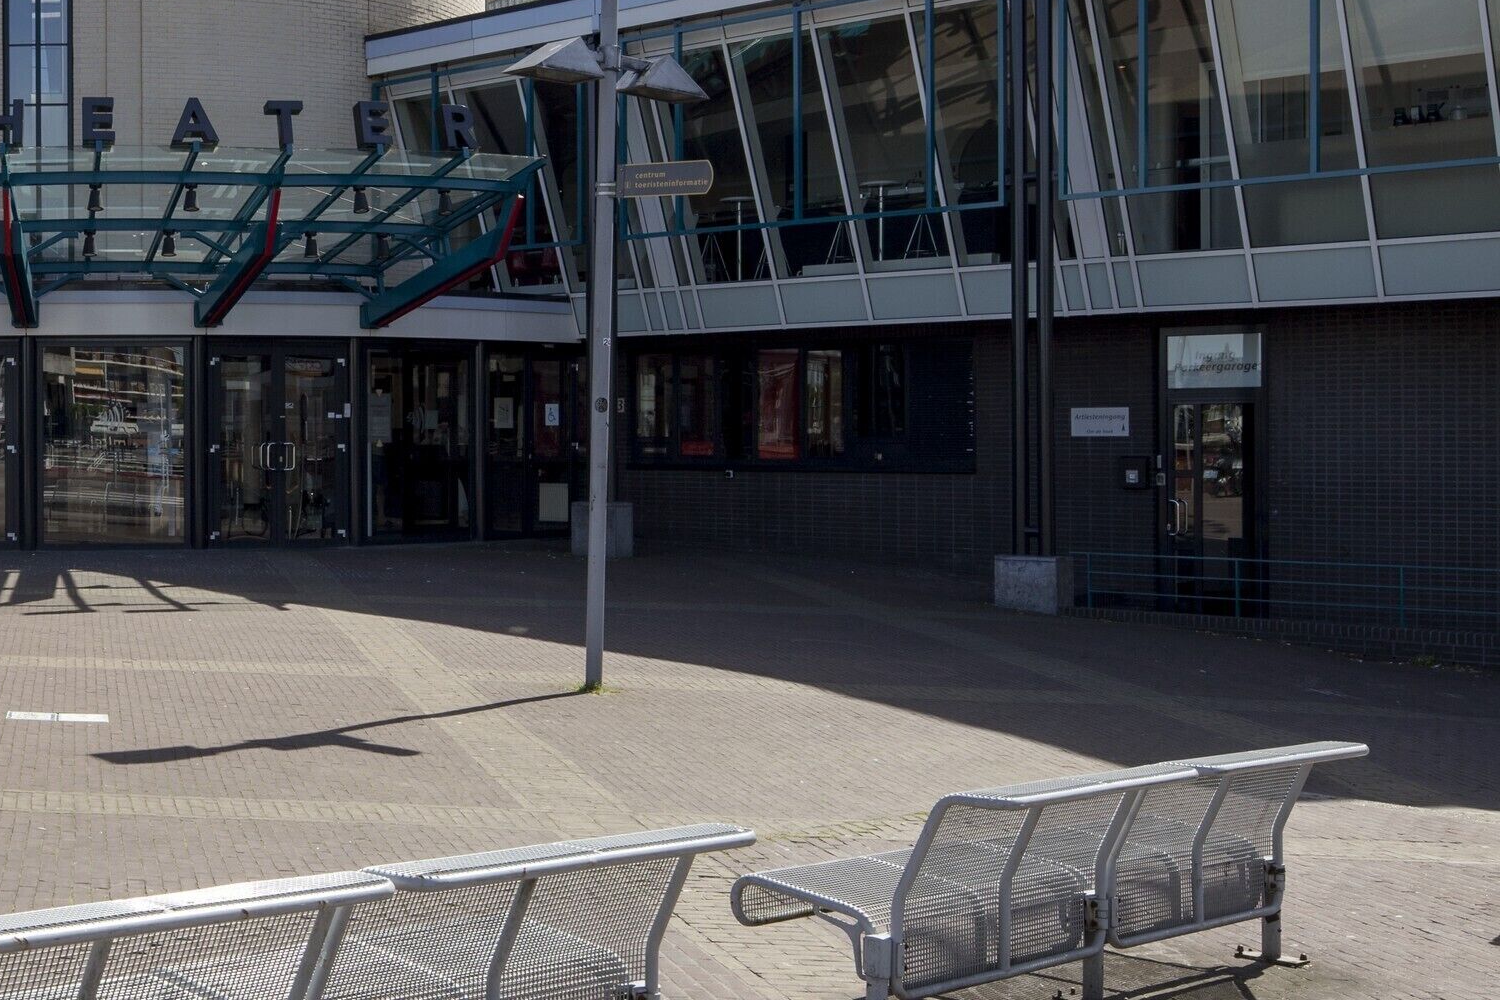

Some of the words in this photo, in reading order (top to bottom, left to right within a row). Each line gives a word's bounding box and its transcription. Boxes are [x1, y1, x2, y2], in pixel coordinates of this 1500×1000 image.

[635, 171, 666, 179] centrum
[634, 178, 709, 189] toeristeninformatie
[1174, 361, 1259, 373] Parkeergarage
[1074, 413, 1127, 421] Artiesteningang
